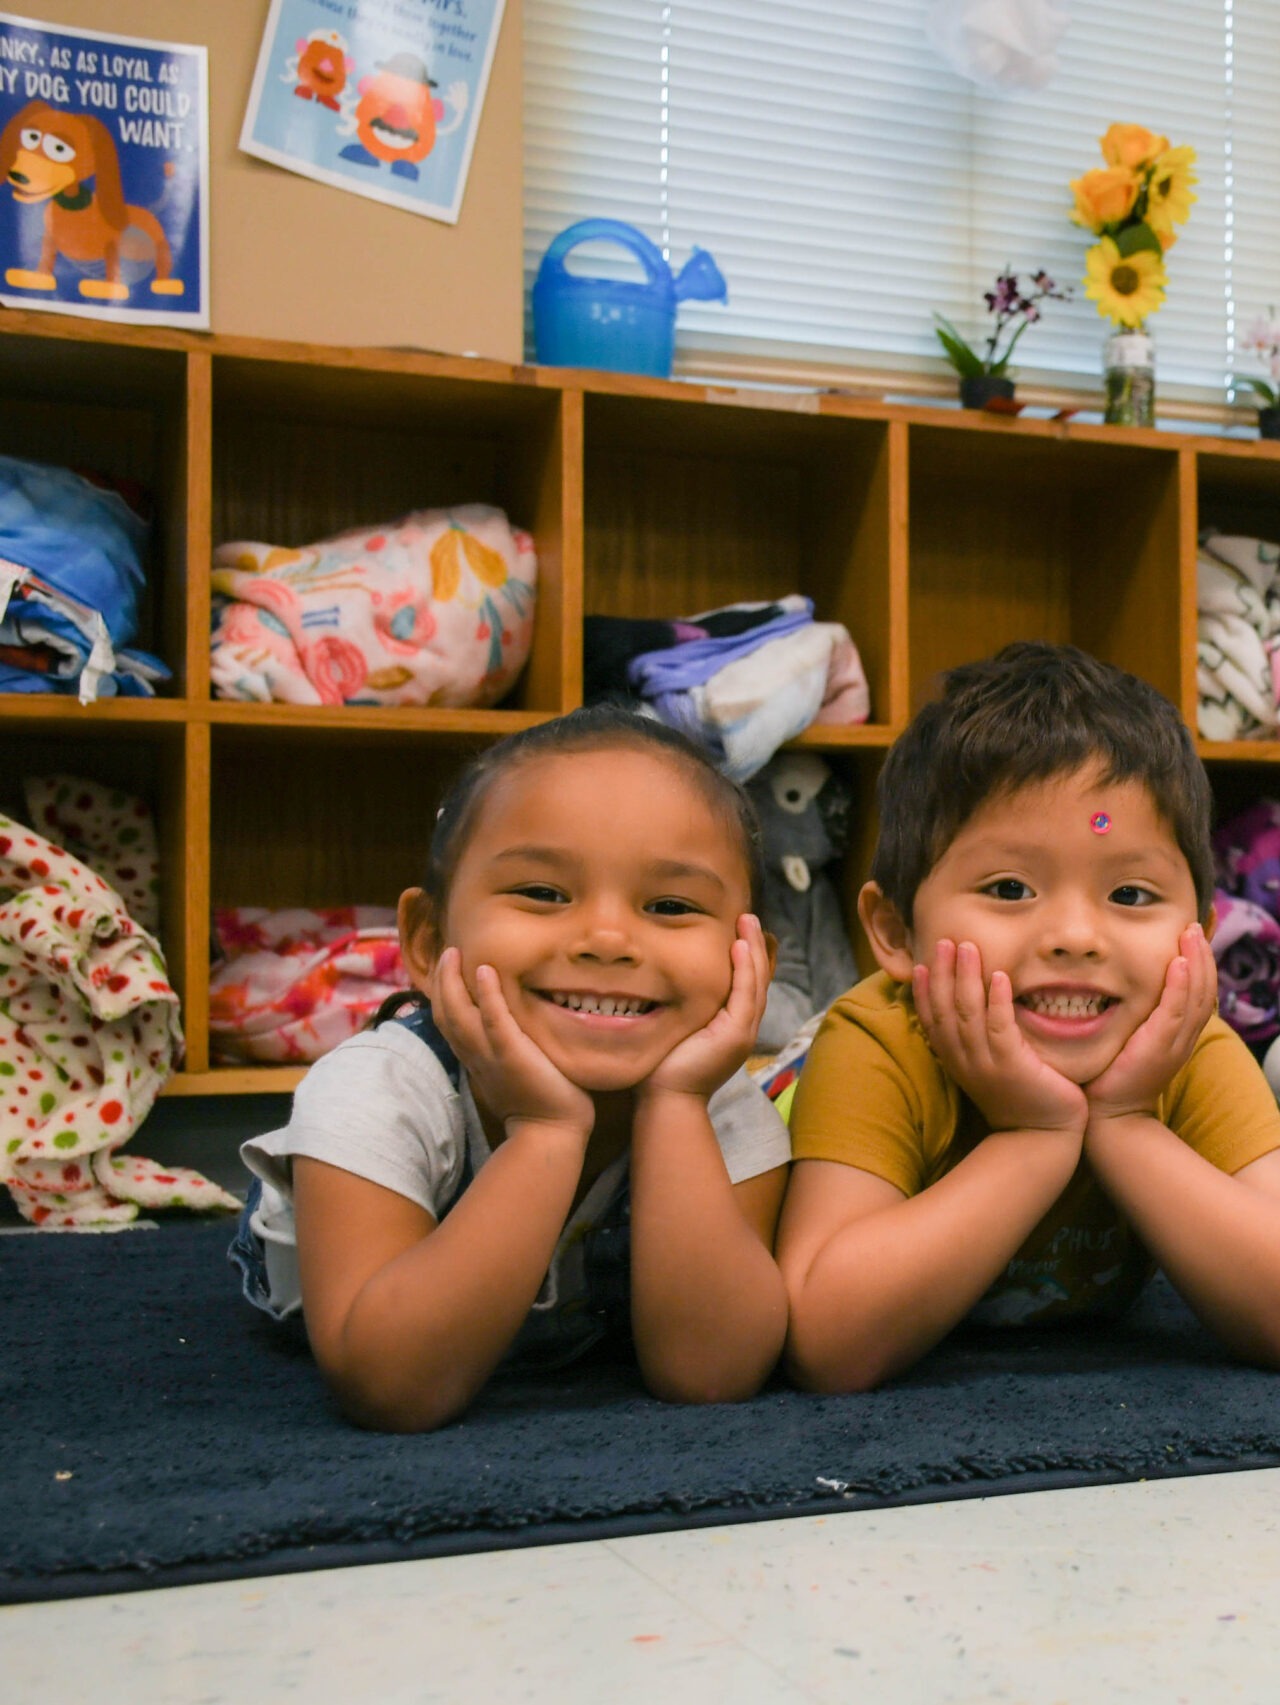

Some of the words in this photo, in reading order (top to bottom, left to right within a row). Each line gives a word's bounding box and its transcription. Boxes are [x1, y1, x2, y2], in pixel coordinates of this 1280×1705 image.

[51, 47, 72, 71] AS
[76, 50, 98, 75] AS
[102, 53, 154, 84] LOYAL
[158, 62, 179, 85] AS
[25, 70, 71, 103] DOG
[75, 79, 118, 110] YOU
[125, 85, 191, 118] COULD
[118, 115, 194, 153] WANT.
